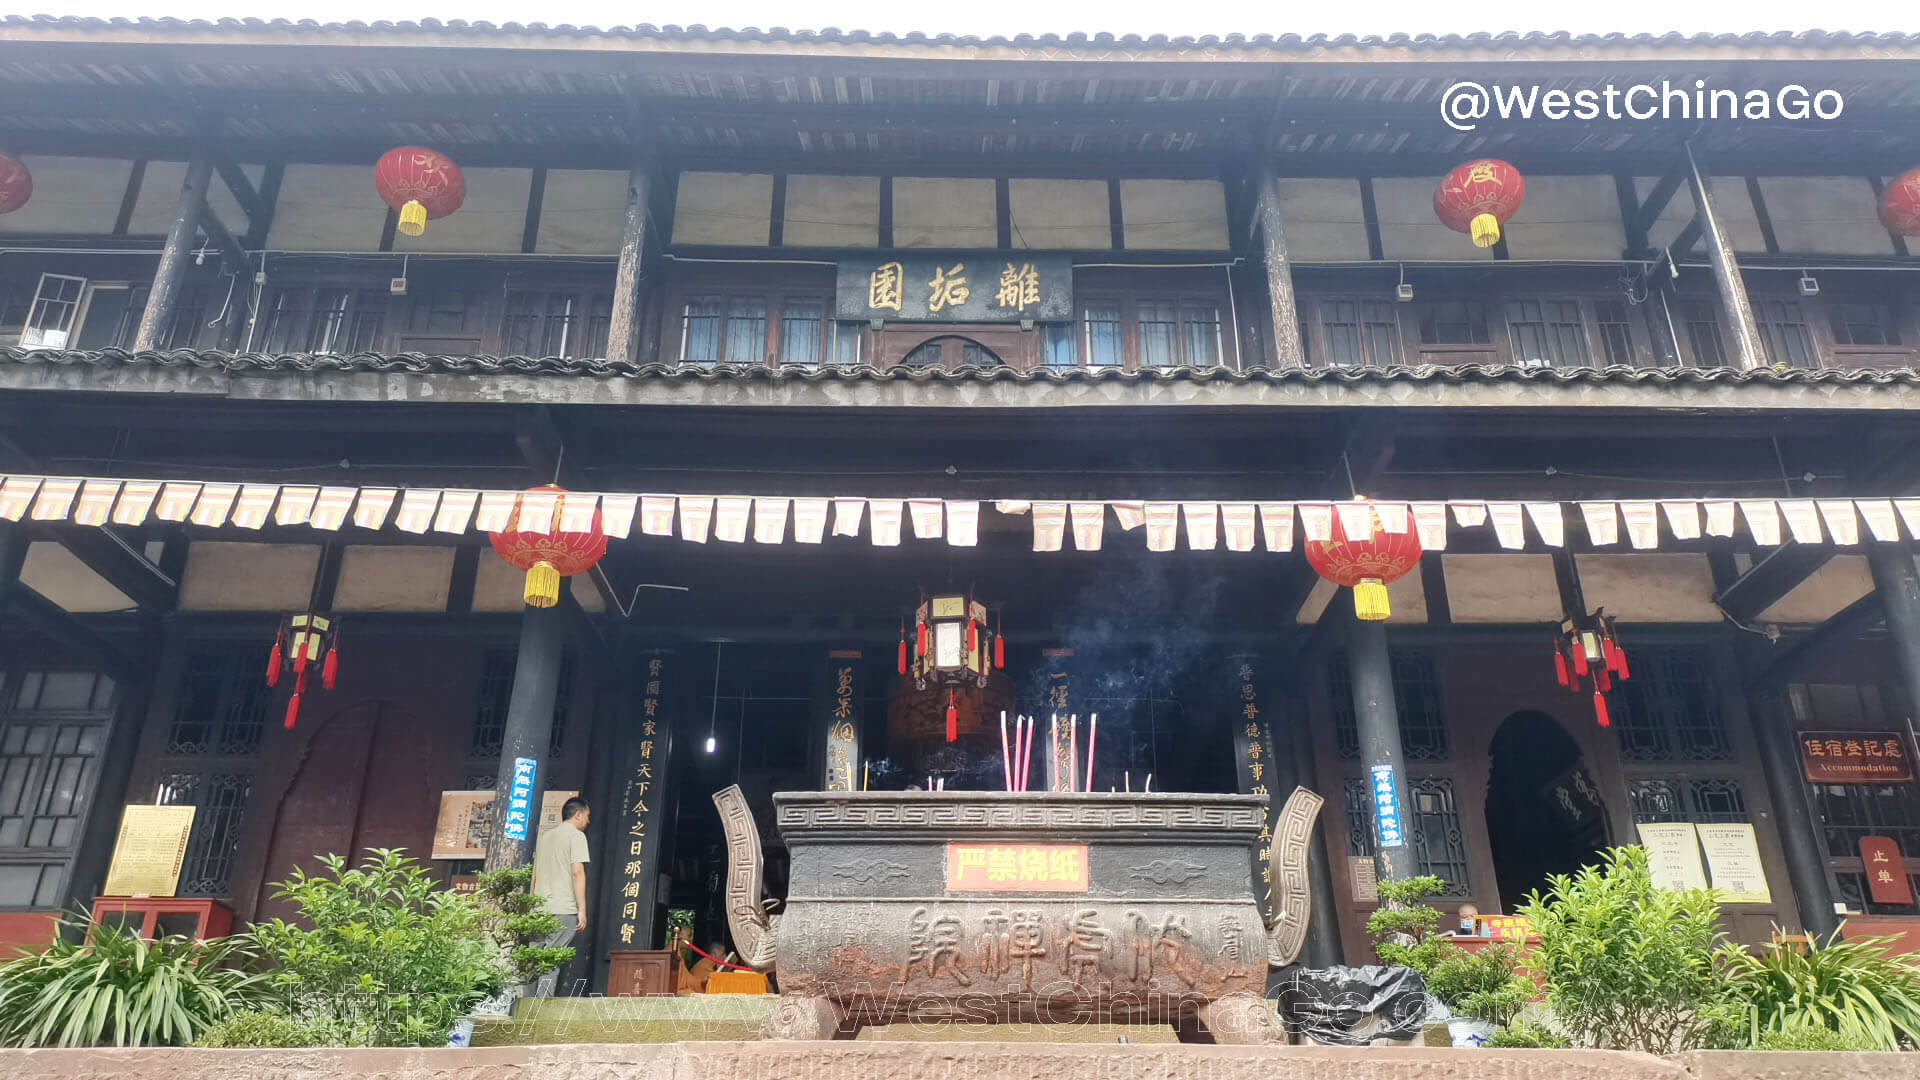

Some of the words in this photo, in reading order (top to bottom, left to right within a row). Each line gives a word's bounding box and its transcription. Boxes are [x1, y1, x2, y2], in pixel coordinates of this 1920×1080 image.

[1804, 740, 1903, 758] 住宿登記處
[1820, 763, 1899, 773] Accommodation
[956, 848, 1080, 882] 严禁烧纸
